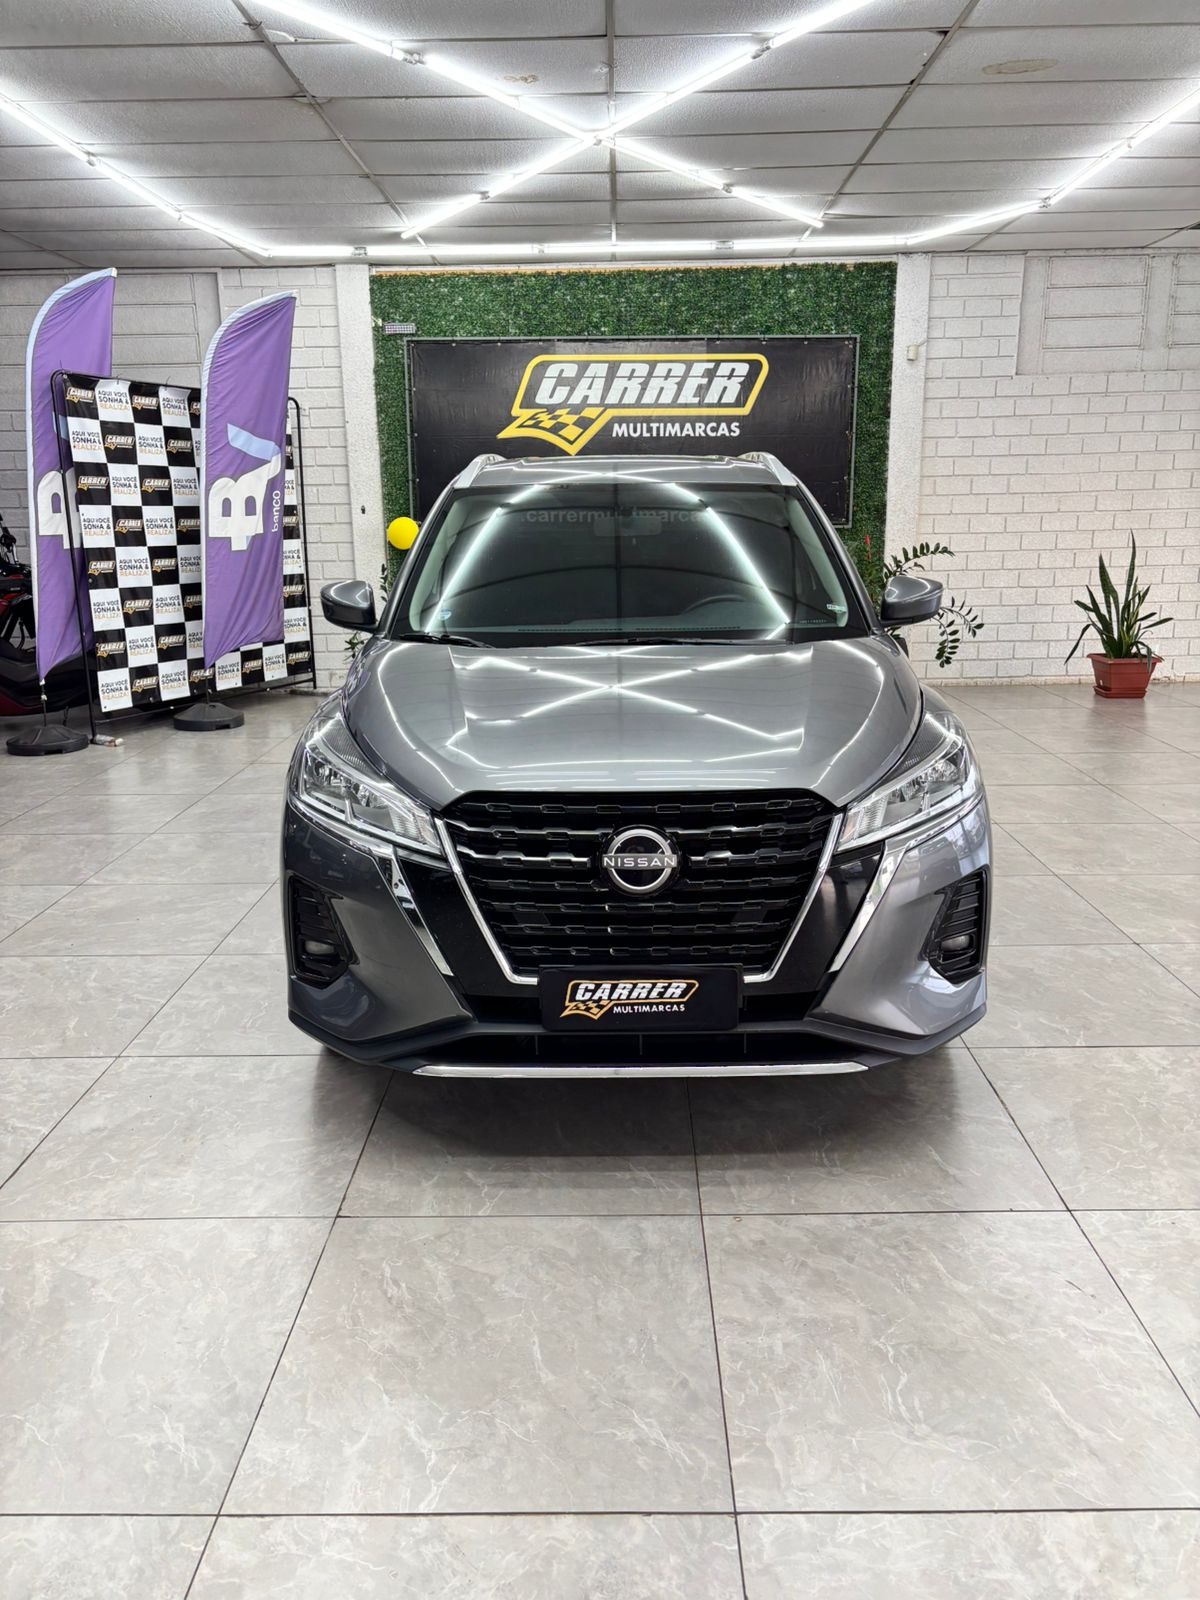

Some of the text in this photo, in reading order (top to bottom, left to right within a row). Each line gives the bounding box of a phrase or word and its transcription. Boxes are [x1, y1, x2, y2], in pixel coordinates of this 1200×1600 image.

[534, 361, 750, 405] CARRER
[612, 421, 740, 437] MULTIMARCAS
[272, 490, 280, 532] banco
[101, 686, 122, 694] SONHA
[603, 857, 676, 867] NISSAN
[575, 982, 689, 1001] CARRER
[613, 1004, 686, 1014] MULTIMARCAS
